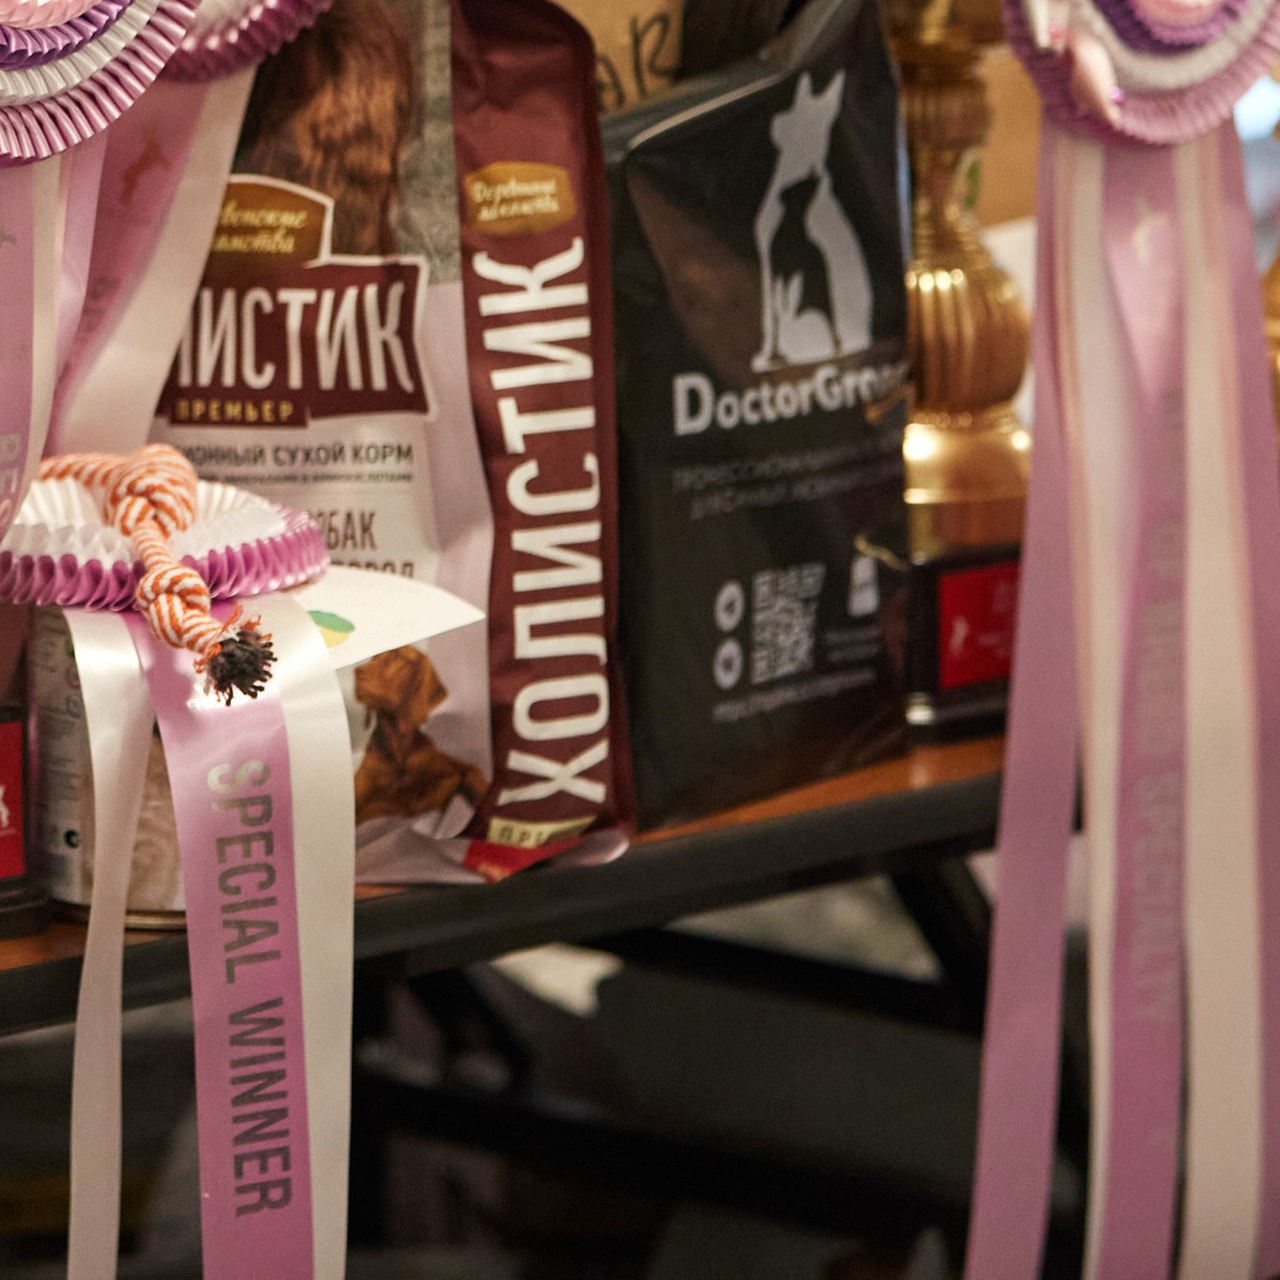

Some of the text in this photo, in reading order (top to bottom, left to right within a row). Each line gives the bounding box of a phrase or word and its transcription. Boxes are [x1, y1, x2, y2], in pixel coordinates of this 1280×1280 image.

[177, 400, 294, 422] ПРЕМЬЕР
[273, 443, 344, 467] СУХОЙ
[352, 442, 414, 465] КОРМ
[473, 236, 610, 806] ХОЛИСТИК
[207, 759, 293, 1217] SPECIAL WINNER
